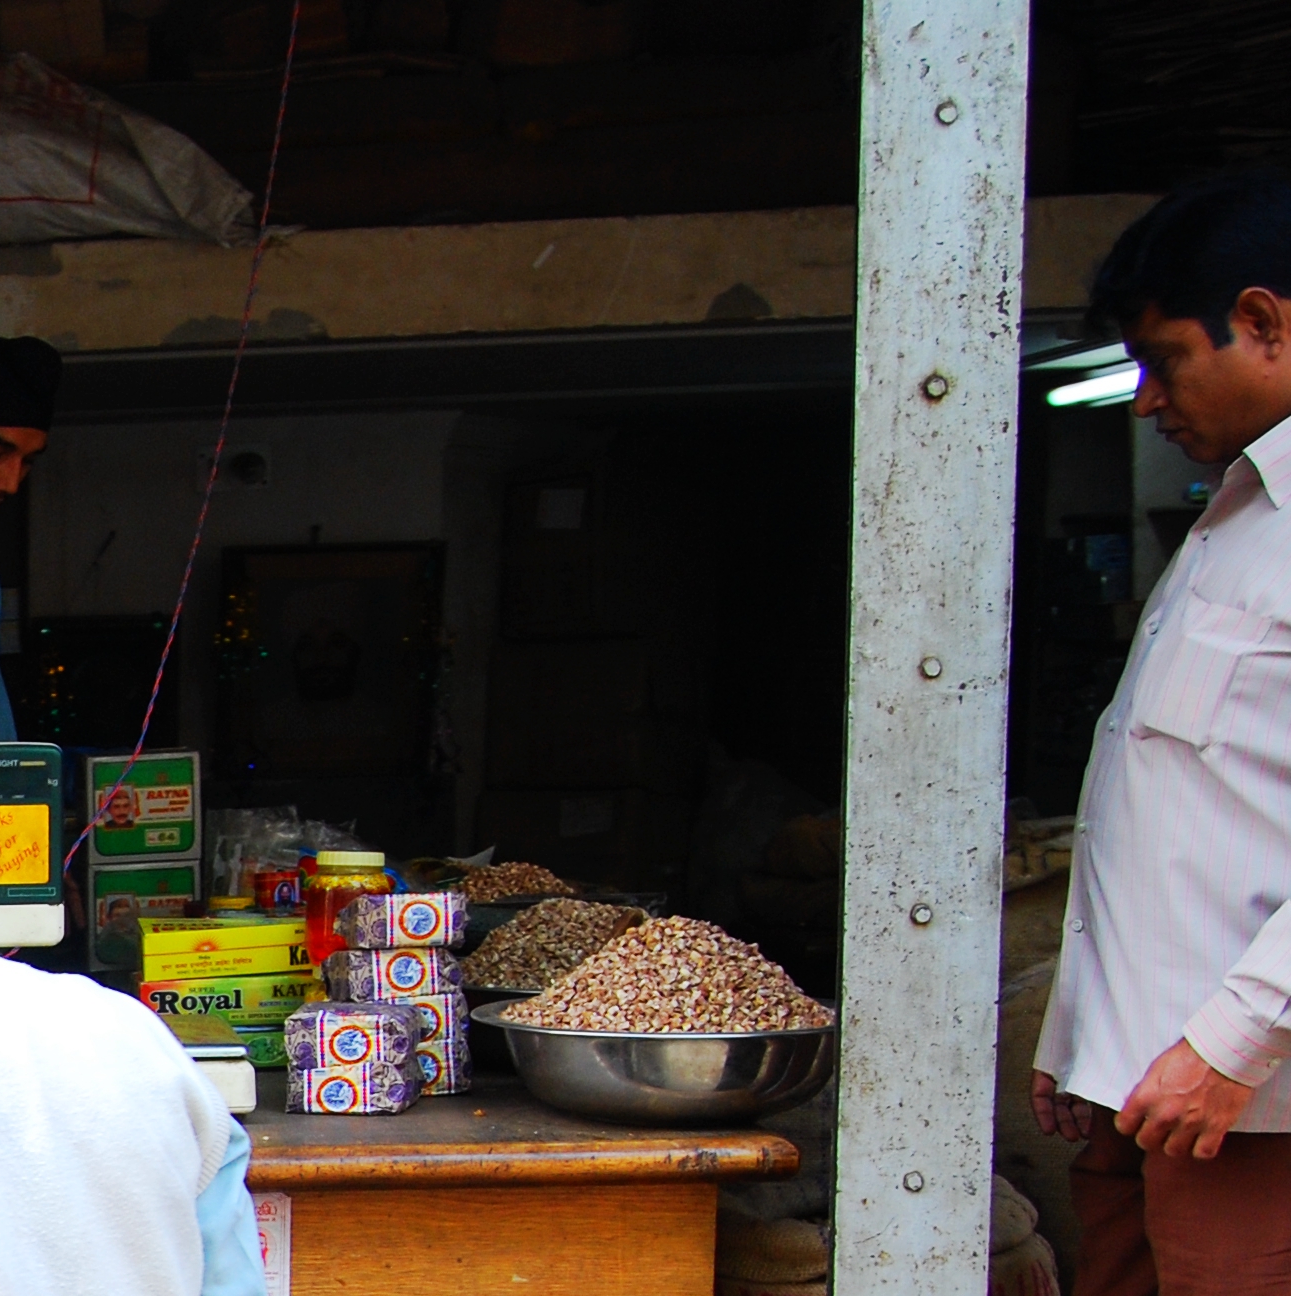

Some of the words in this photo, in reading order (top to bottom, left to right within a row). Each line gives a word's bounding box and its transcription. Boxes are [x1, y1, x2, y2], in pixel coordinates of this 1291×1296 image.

[47, 778, 59, 788] kg
[146, 789, 189, 801] RATNA
[188, 986, 215, 994] SUPER
[272, 983, 312, 998] KAT
[149, 989, 244, 1016] Royal
